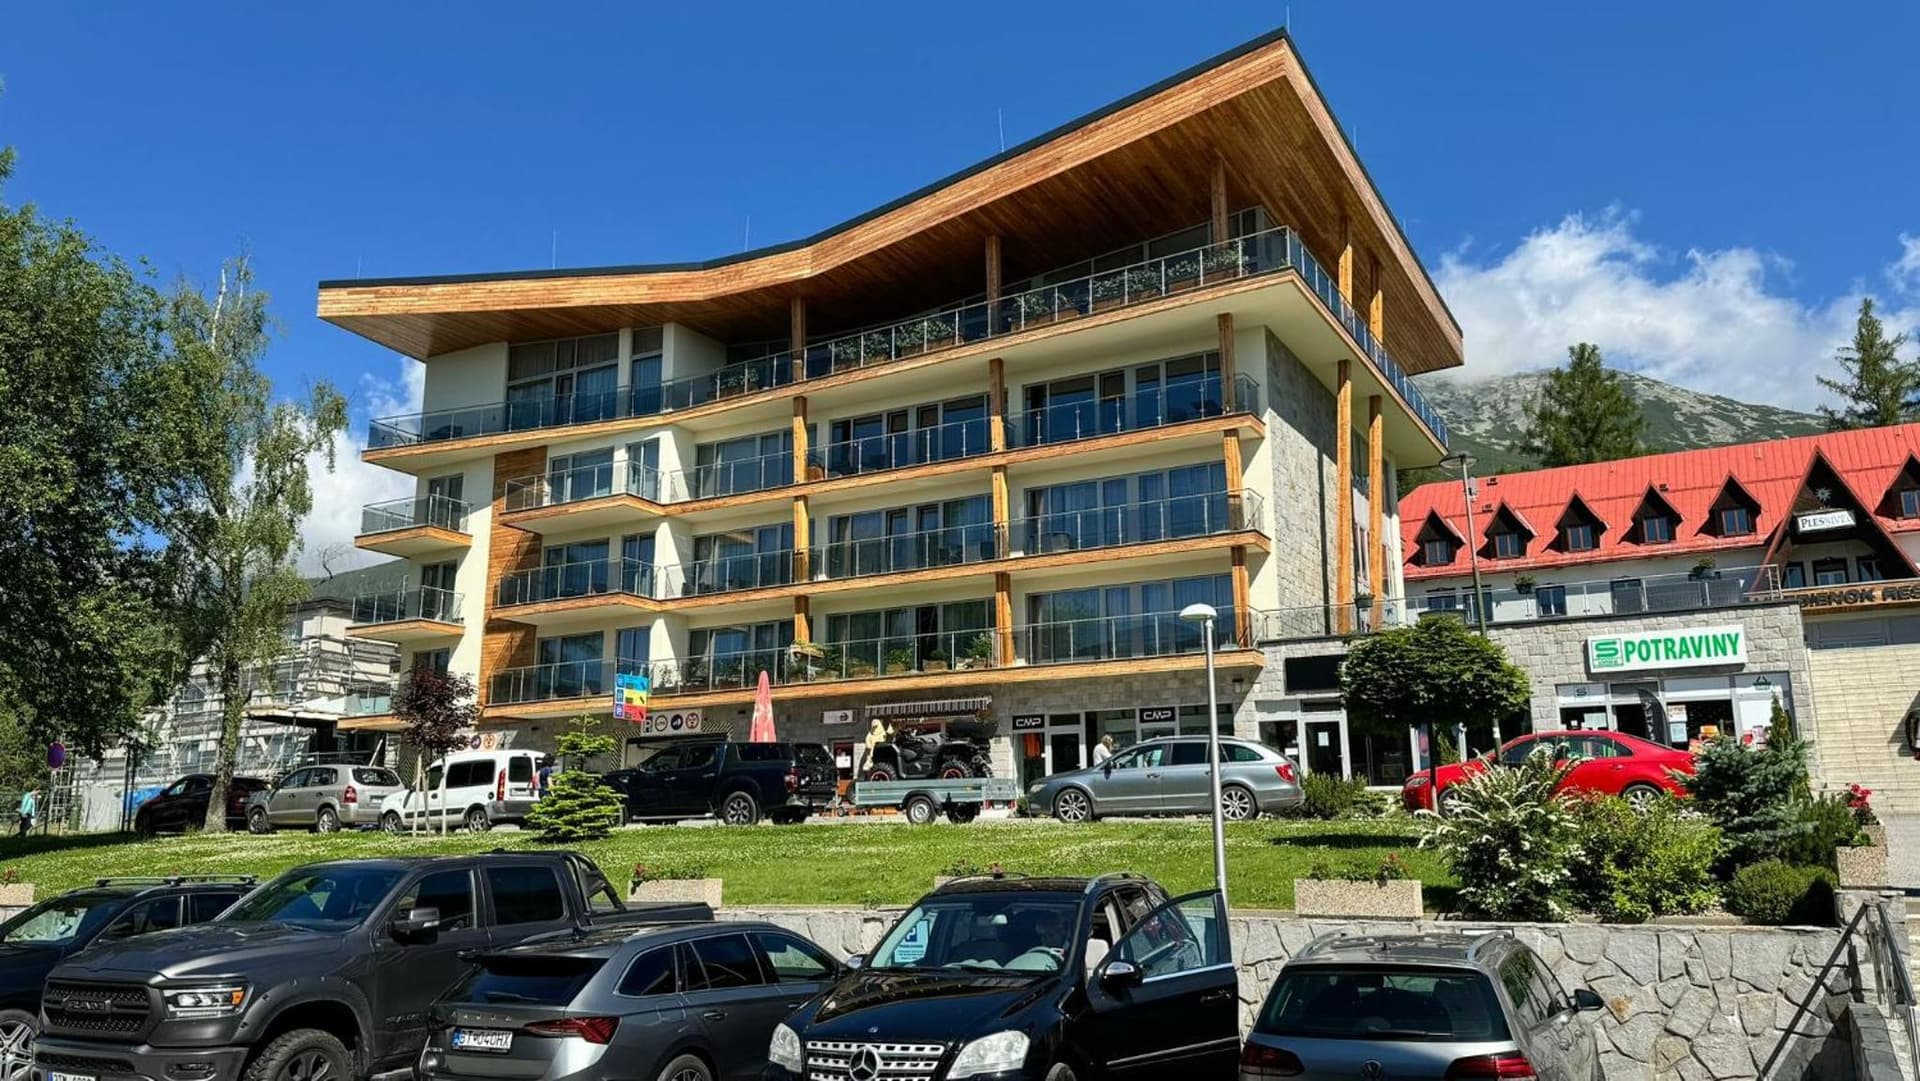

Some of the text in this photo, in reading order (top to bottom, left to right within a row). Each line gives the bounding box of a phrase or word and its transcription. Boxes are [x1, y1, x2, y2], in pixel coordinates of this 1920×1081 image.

[1623, 632, 1740, 663] POTRAVINY
[1143, 711, 1172, 721] CMP
[1015, 717, 1041, 727] CMP
